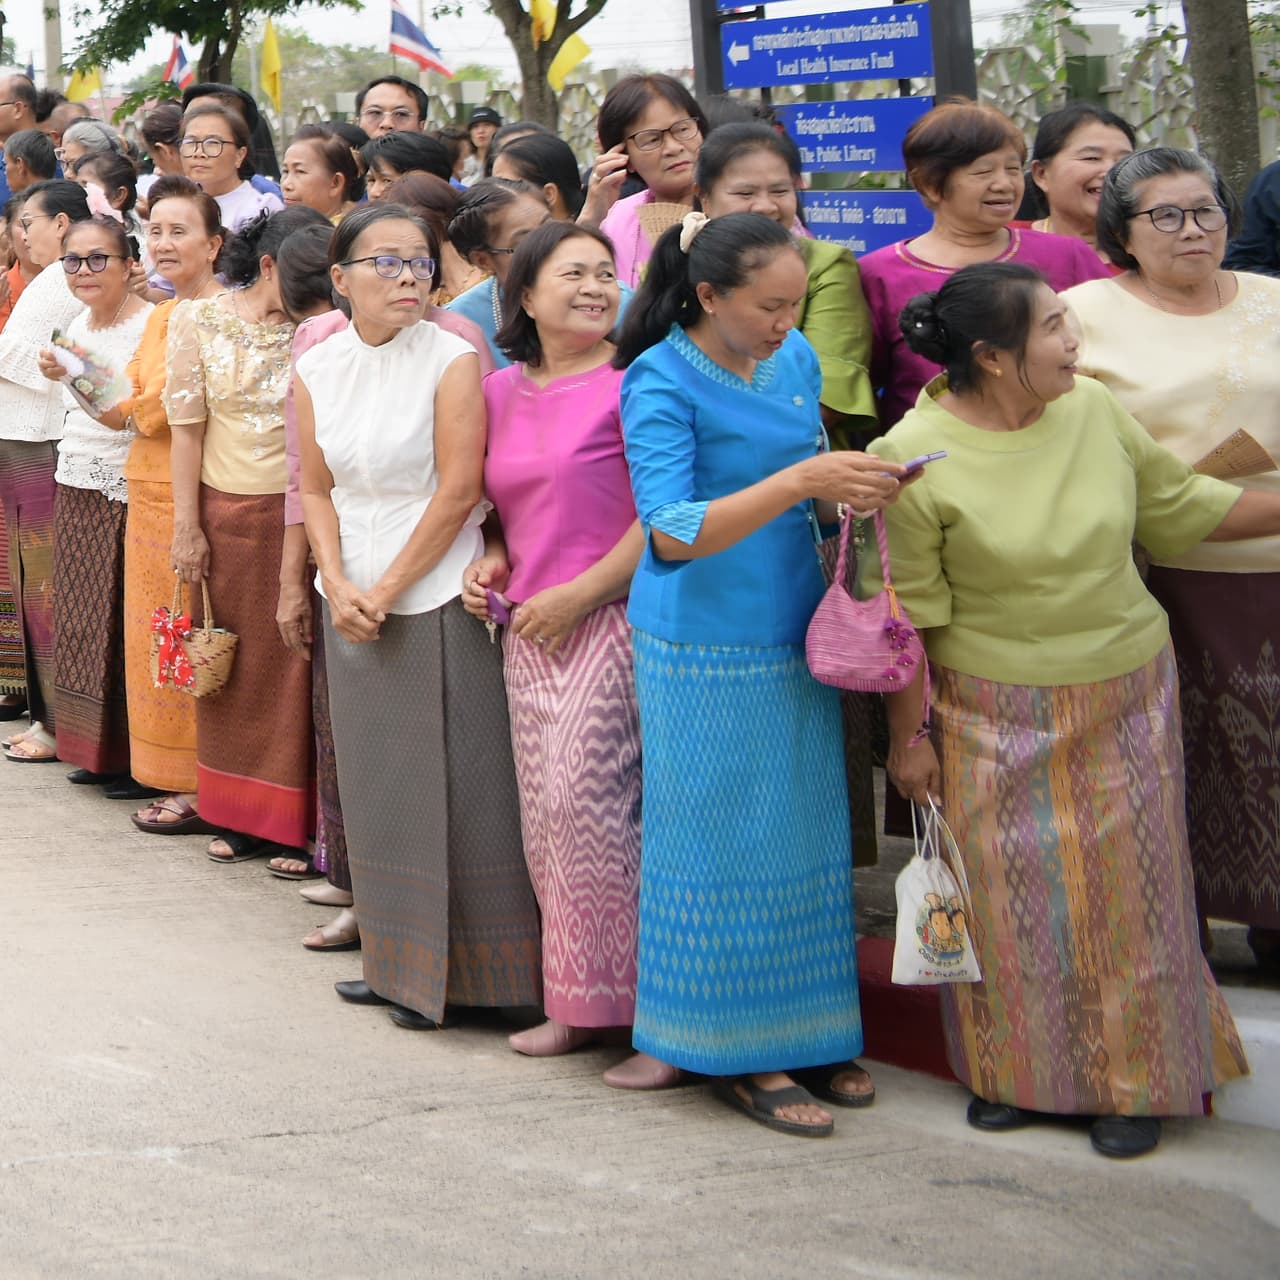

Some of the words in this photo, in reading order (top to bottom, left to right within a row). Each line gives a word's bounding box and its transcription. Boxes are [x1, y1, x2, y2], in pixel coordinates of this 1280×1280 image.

[776, 59, 799, 77] Local
[800, 56, 828, 75] Health
[828, 55, 870, 73] Insurance
[870, 50, 895, 70] Fund
[798, 146, 815, 163] The
[815, 144, 842, 163] Public
[843, 144, 877, 165] Library
